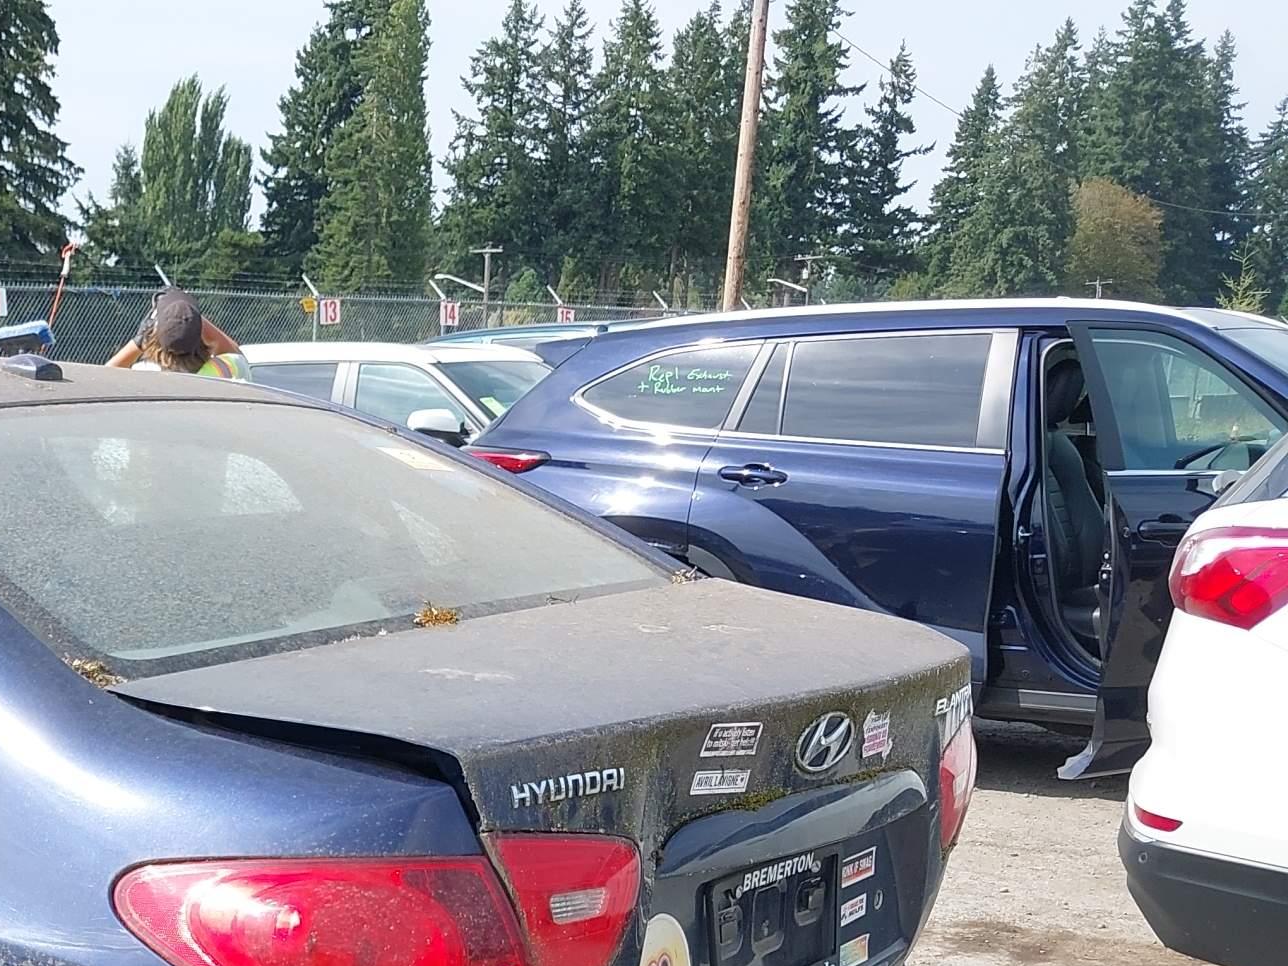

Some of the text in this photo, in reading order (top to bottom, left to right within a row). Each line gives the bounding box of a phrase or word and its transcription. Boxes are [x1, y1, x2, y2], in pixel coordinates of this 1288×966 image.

[324, 301, 337, 322] 13
[444, 304, 456, 324] 14
[510, 767, 625, 809] HYUNDAI
[696, 774, 740, 788] AVRIL LAVIGNE
[742, 852, 815, 893] BREMERTON
